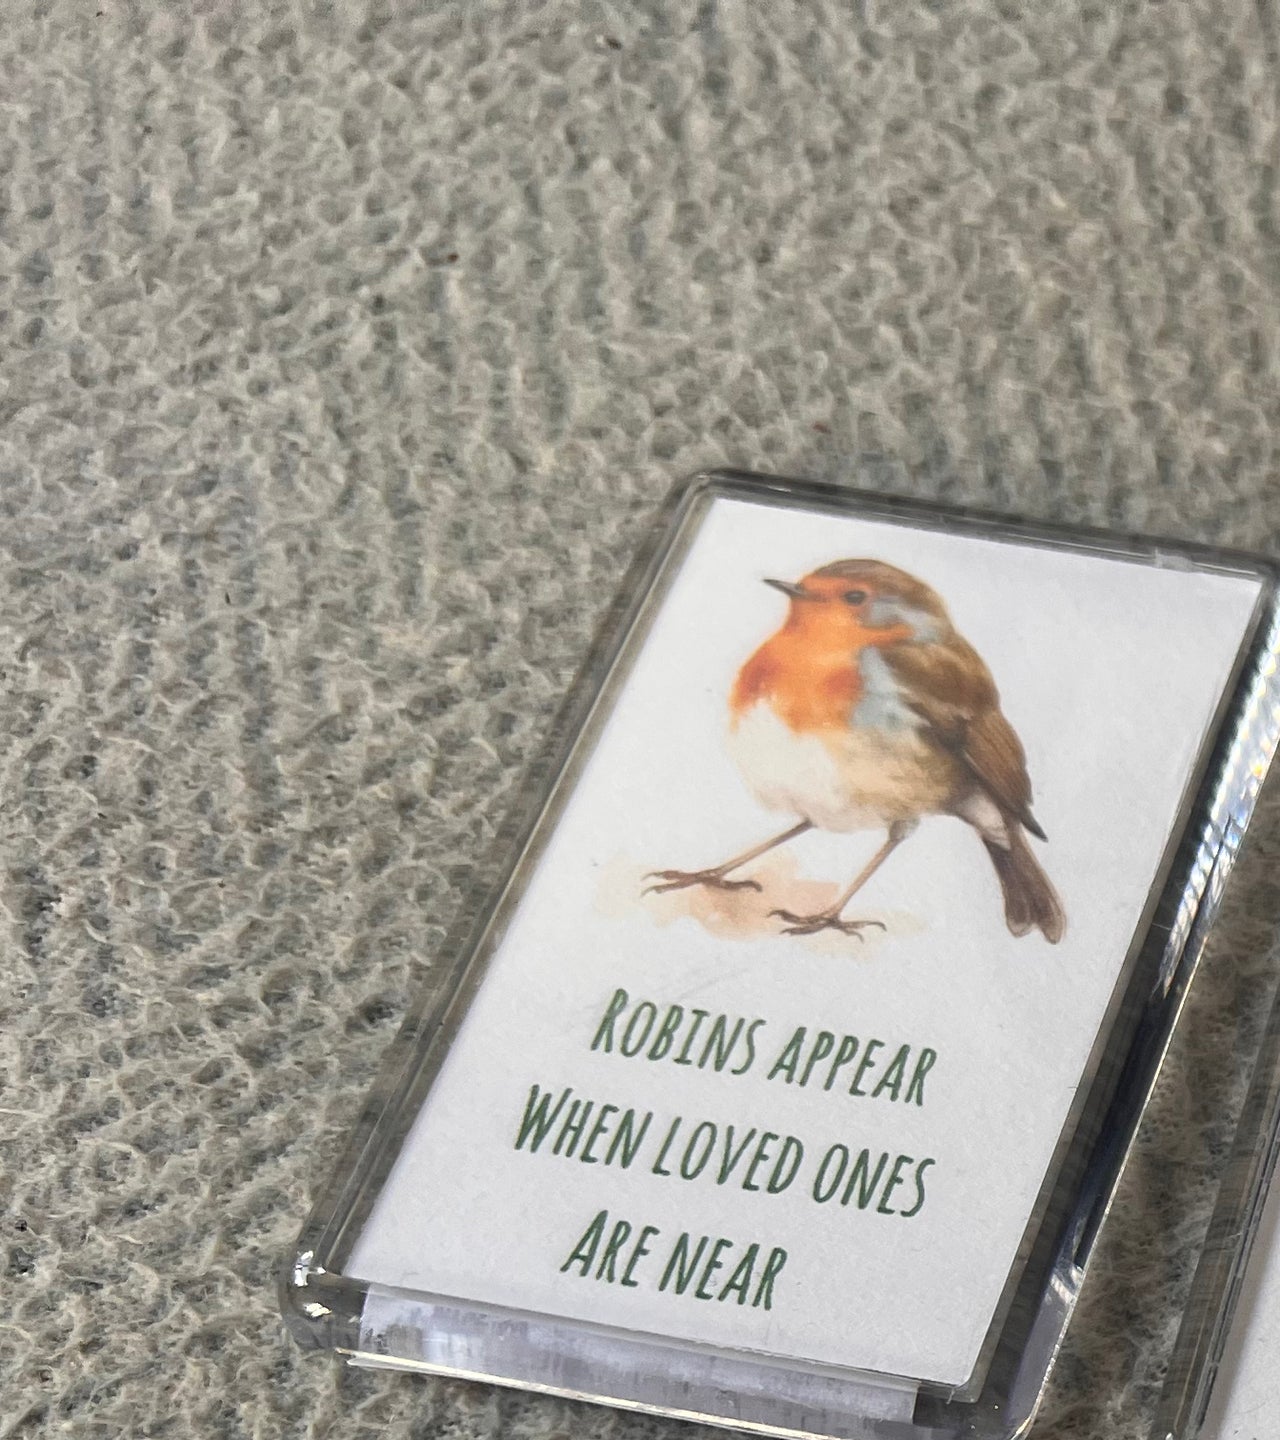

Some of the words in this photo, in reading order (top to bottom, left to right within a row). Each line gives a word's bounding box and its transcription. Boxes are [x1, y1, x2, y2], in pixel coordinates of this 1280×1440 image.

[589, 987, 768, 1077] ROBINS
[765, 1025, 938, 1108] APPEAR
[512, 1082, 655, 1171] WHEN
[650, 1115, 805, 1196] LOVED
[810, 1142, 937, 1219] ONES
[558, 1208, 662, 1289] ARE
[656, 1231, 789, 1313] NEAR
